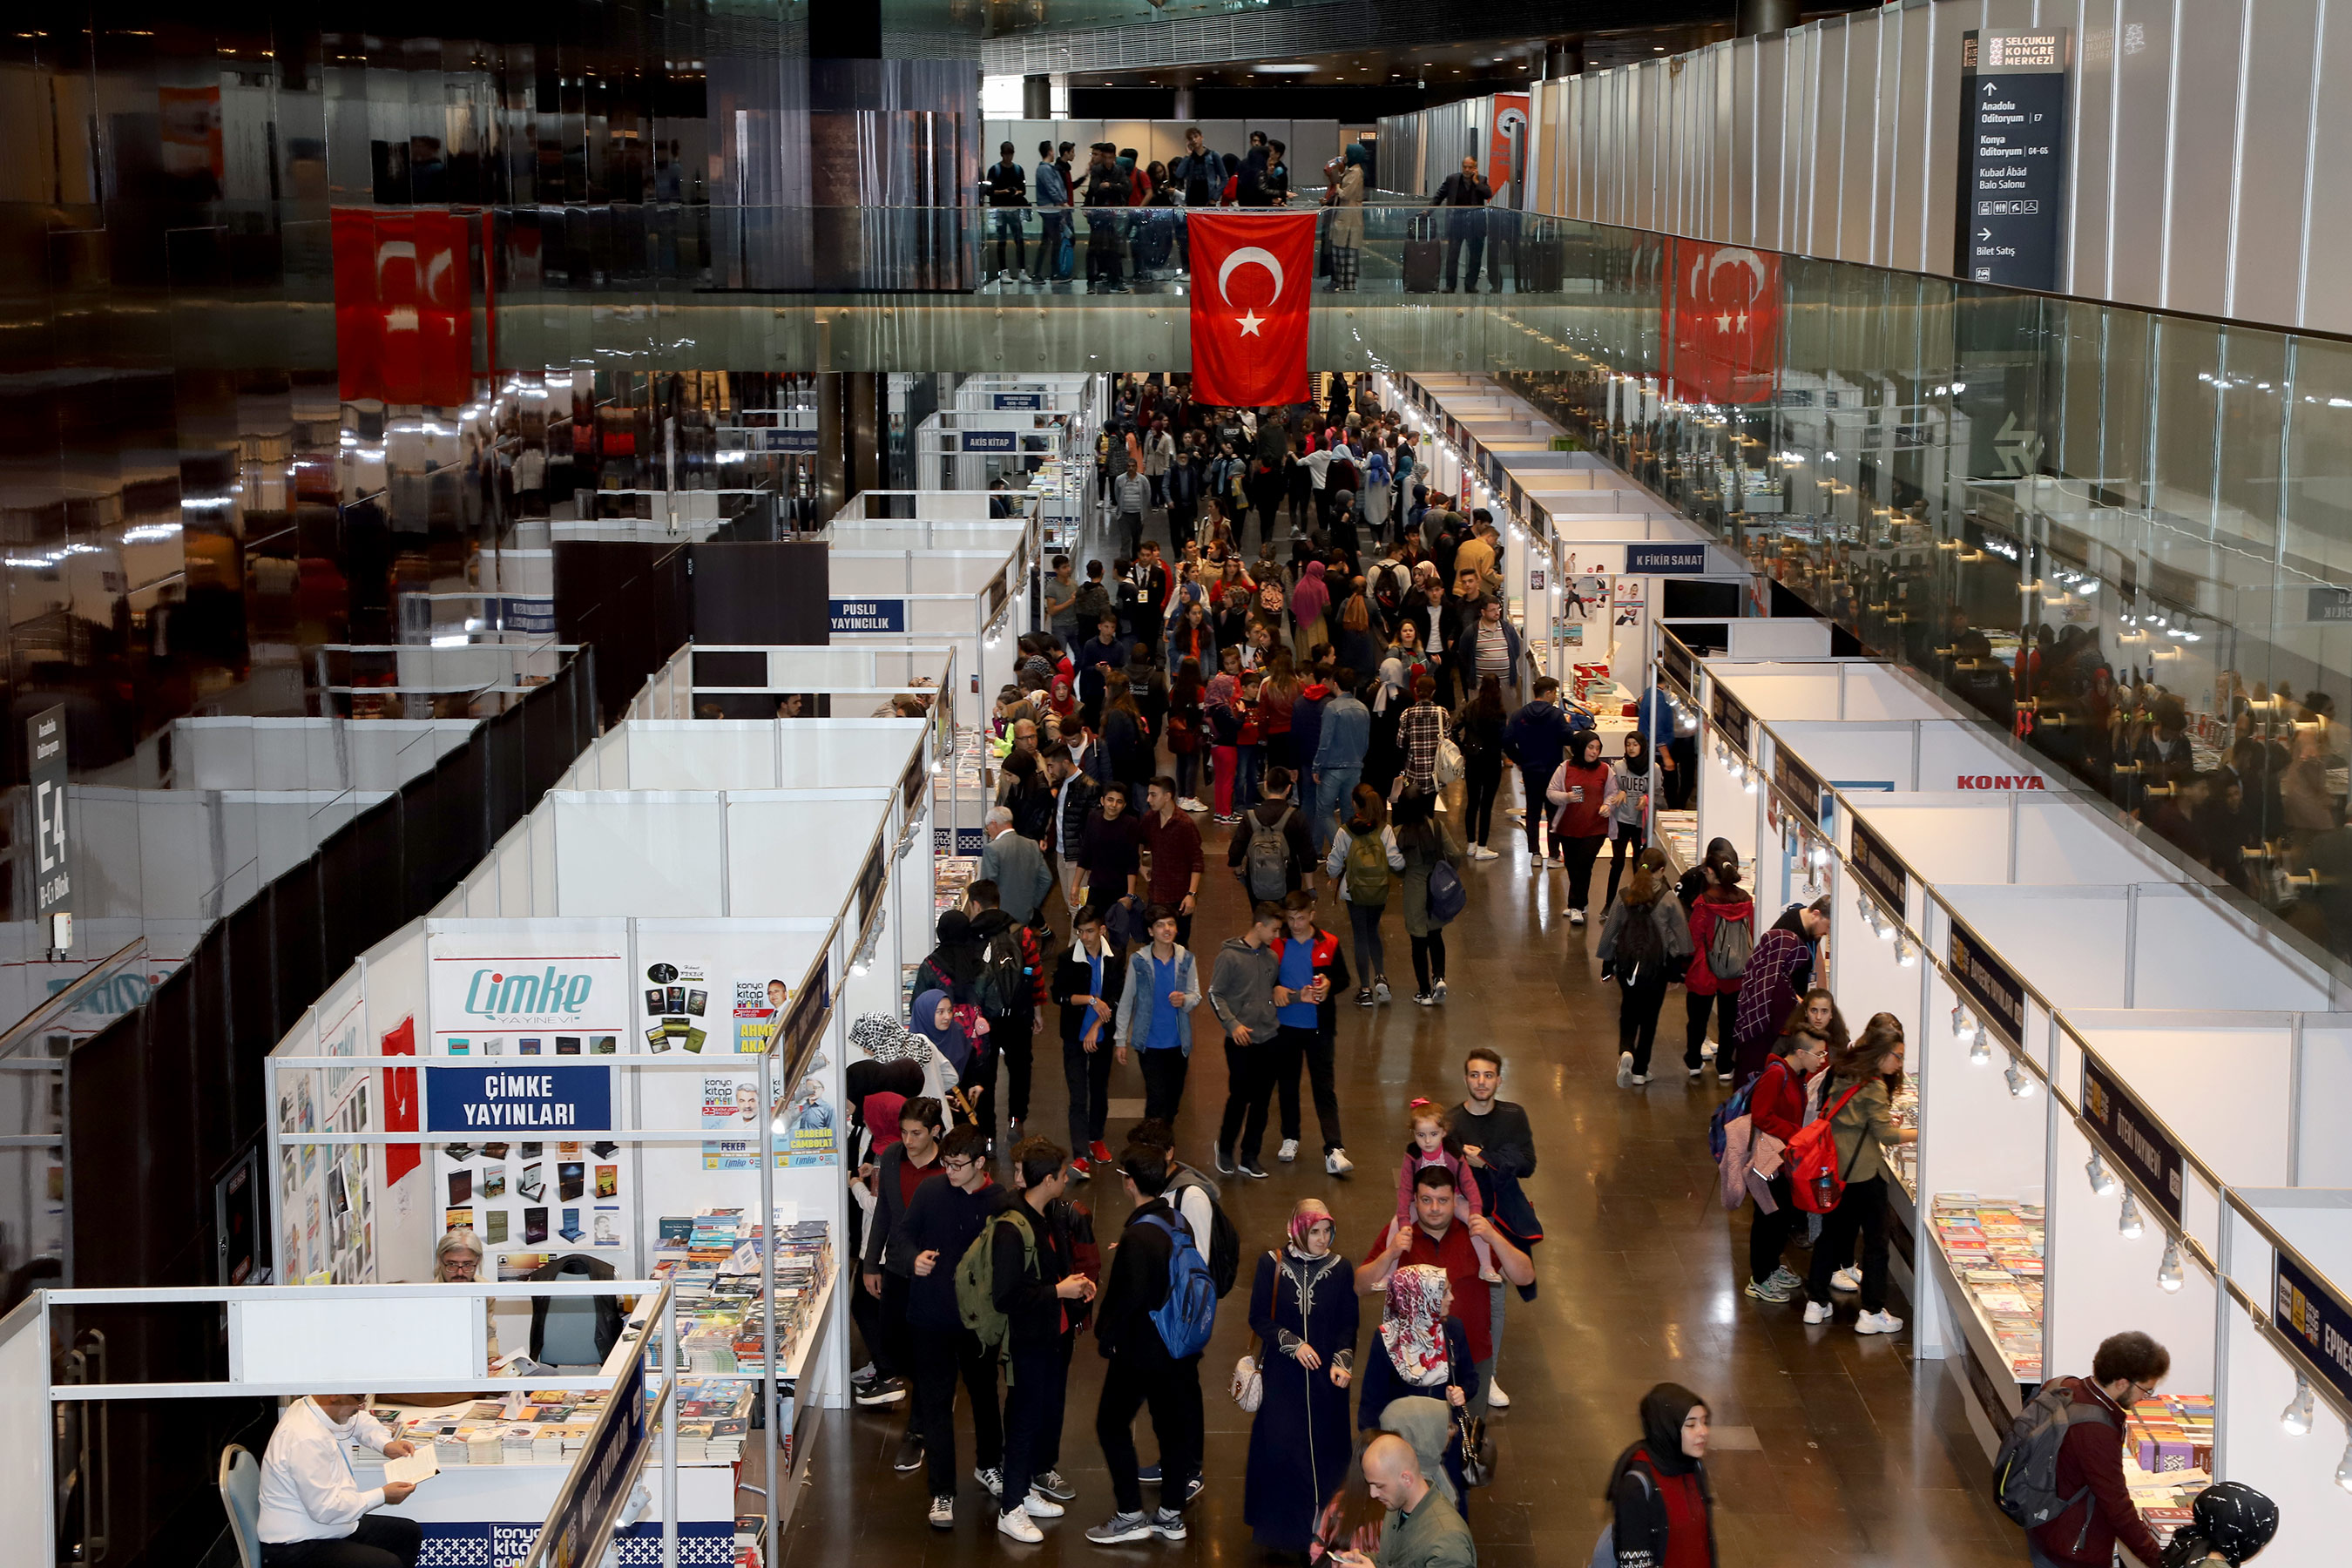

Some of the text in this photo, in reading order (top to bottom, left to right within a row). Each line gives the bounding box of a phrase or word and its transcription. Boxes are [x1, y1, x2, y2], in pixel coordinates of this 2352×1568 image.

[2005, 36, 2055, 47] SELÇUKLU
[2005, 46, 2054, 56] KONGRE
[2004, 54, 2054, 65] MERKEZİ
[1982, 101, 2016, 111] Anadolu
[1981, 113, 2043, 125] Oditoryum E7
[1980, 135, 2005, 145] Konya
[1980, 146, 2023, 158] Oditoryum
[1979, 166, 2027, 178] Kubad Âbâd
[1979, 179, 2025, 190] Balo Salonu
[1977, 247, 2016, 257] Bilet Satış
[970, 436, 1010, 447] AKİS KİTAP
[1636, 553, 1704, 566] K FİKİR SANAT
[842, 604, 876, 615] PUSLU
[830, 618, 889, 629] YAYINCILIK
[1957, 775, 2045, 789] KONYA
[37, 780, 65, 874] E4
[737, 982, 764, 990] konya
[464, 966, 592, 1020] Çimke
[737, 990, 764, 999] kitap
[497, 1016, 574, 1024] YAYINEVİ
[740, 1024, 779, 1037] AHME
[484, 1071, 553, 1101] ÇİMKE
[705, 1078, 733, 1087] konya
[705, 1086, 733, 1097] kitap
[463, 1103, 576, 1125] YAYINLARI
[794, 1127, 834, 1139] EBABEKİR
[721, 1142, 746, 1151] PEKER
[790, 1138, 834, 1149] CAMBOLAT
[493, 1539, 532, 1556] kita
